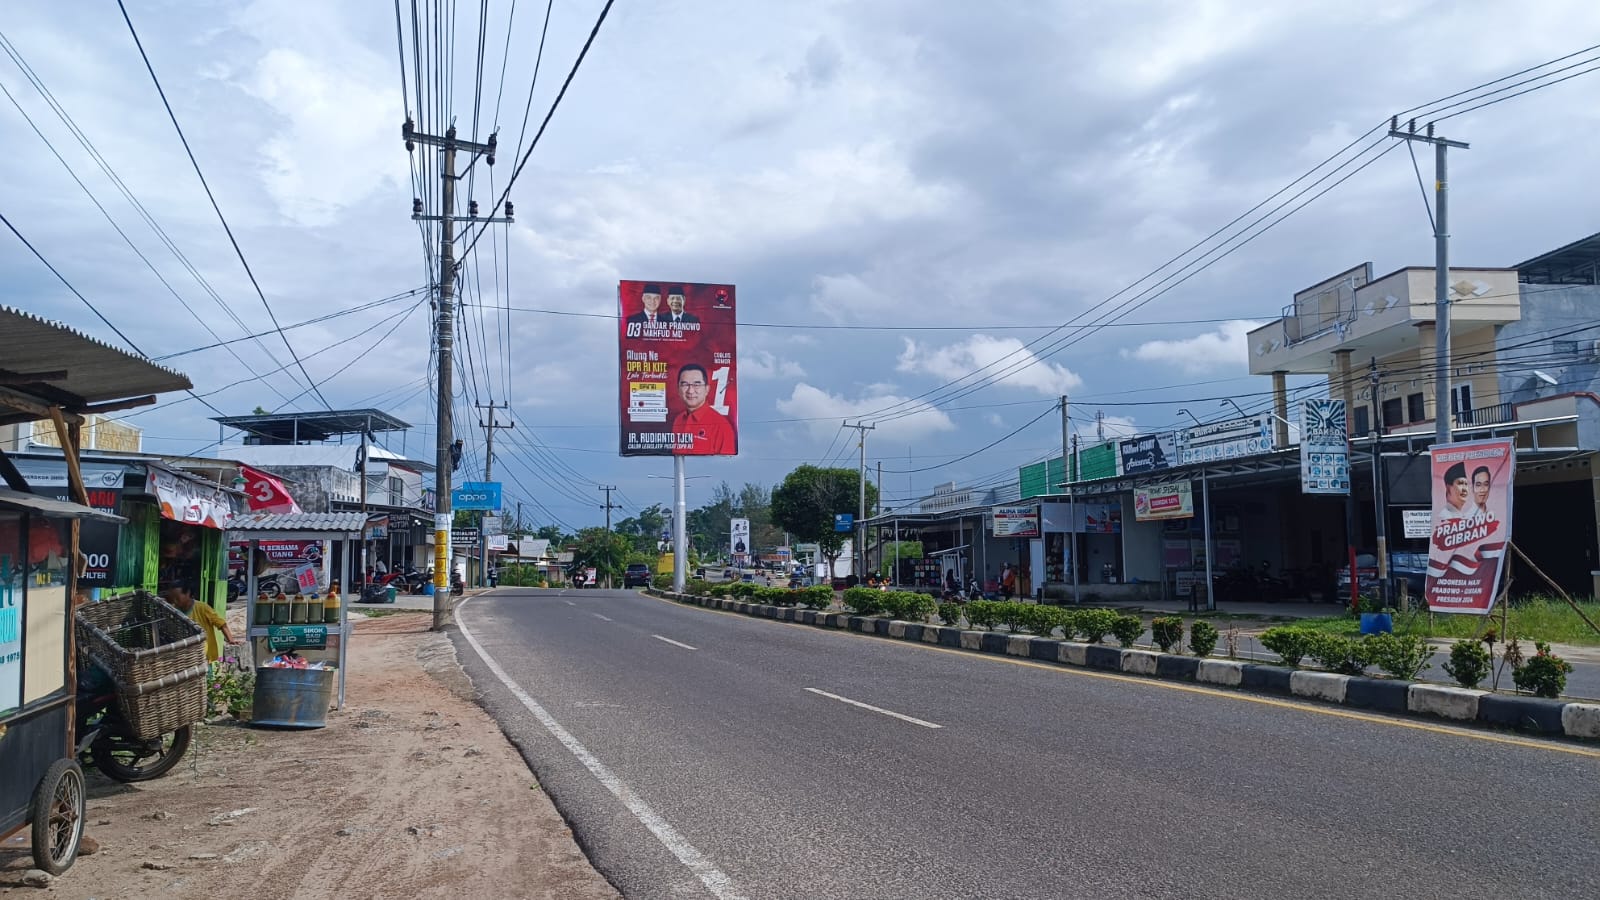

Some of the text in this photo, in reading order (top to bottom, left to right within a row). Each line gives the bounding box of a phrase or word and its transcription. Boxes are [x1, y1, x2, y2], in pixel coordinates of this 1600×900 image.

[627, 322, 641, 337] 03
[643, 321, 700, 331] GANJAR PRANOWO
[643, 329, 683, 338] MAHFUD MD
[627, 361, 641, 372] DPR
[652, 362, 668, 373] KITE
[709, 366, 730, 415] 1
[628, 432, 693, 443] IR. RUDIANTO TJEN
[253, 480, 274, 502] 3
[1437, 511, 1495, 537] PRABOWO
[1444, 525, 1488, 546] GIBRAN
